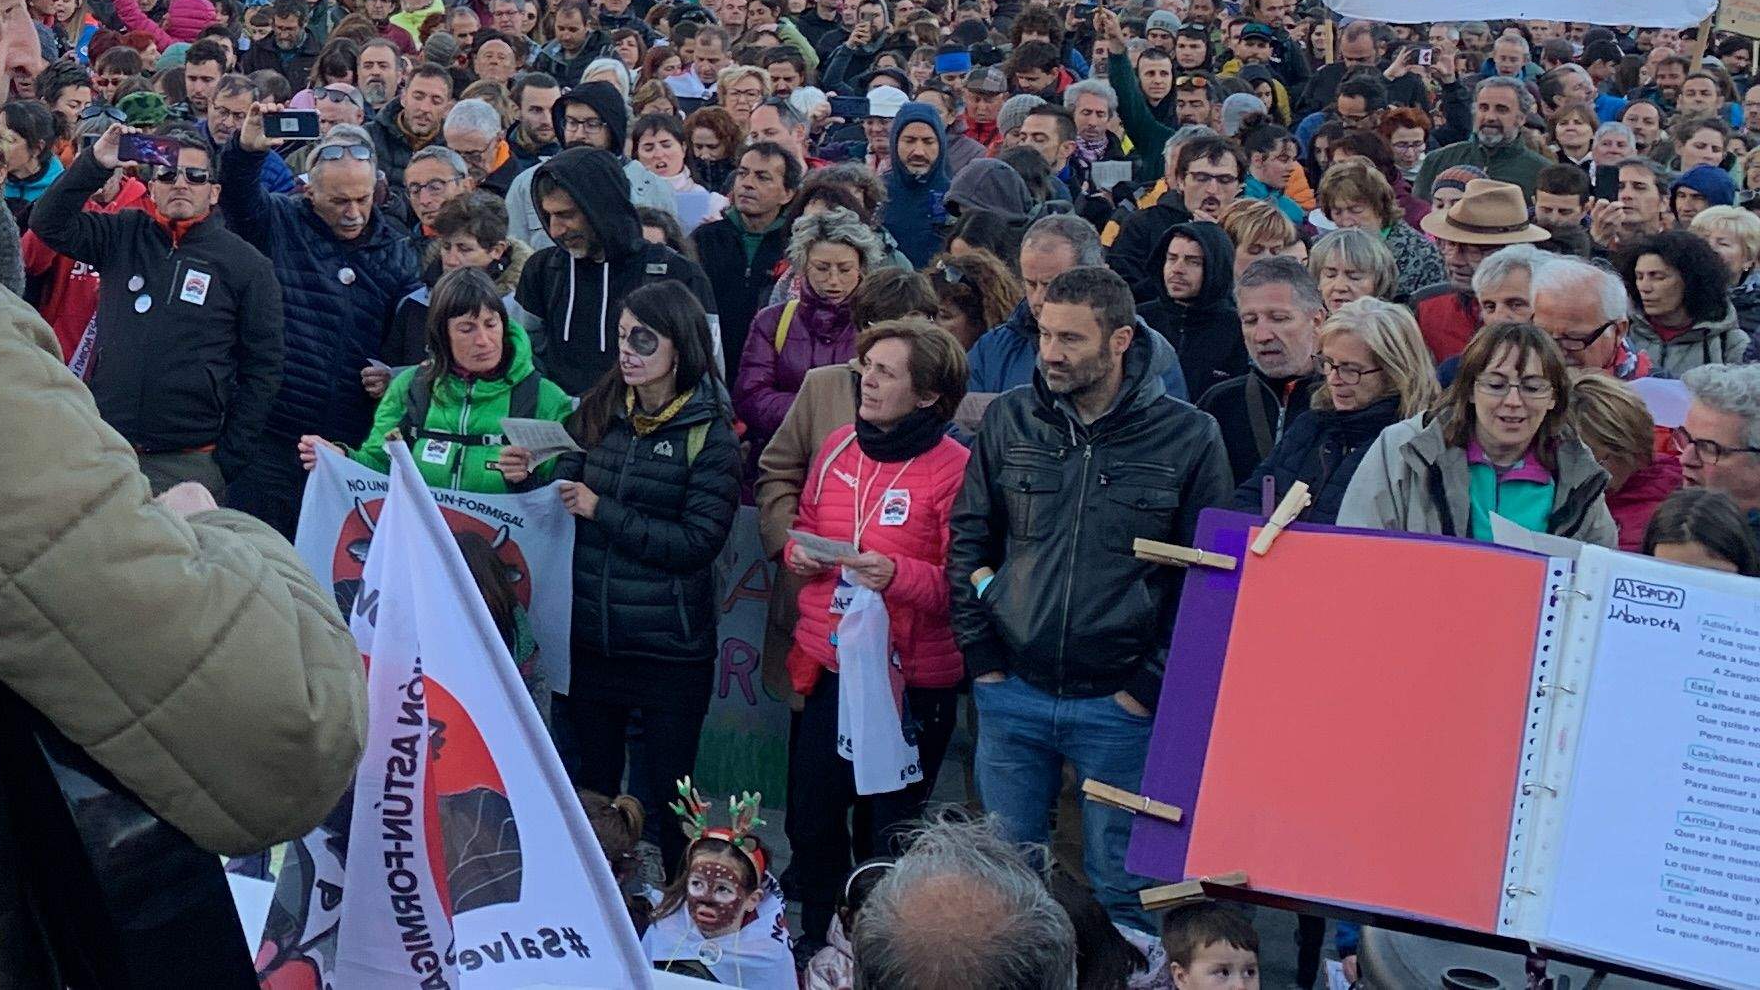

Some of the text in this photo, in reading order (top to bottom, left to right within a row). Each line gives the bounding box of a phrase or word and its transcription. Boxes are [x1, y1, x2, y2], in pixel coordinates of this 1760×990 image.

[346, 479, 366, 492] NO
[1718, 637, 1734, 648] los
[1736, 641, 1757, 652] que
[1716, 688, 1729, 696] es
[1731, 689, 1741, 699] la
[1696, 699, 1709, 708] La
[1696, 714, 1718, 725] Que
[1699, 730, 1724, 742] Pero
[1726, 737, 1746, 746] eso
[1691, 748, 1711, 760] Las
[1680, 762, 1695, 772] Se
[1684, 778, 1709, 790] Para
[1674, 828, 1696, 839] Que
[1699, 833, 1712, 843] ya
[1714, 836, 1728, 846] ha
[1664, 842, 1680, 852] De
[1681, 846, 1711, 859] tener
[1712, 853, 1727, 862] en
[1664, 858, 1679, 868] Lo
[1680, 863, 1702, 873] que
[1703, 867, 1724, 878] nos
[1668, 895, 1682, 905] Es
[1731, 893, 1753, 903] que
[1656, 908, 1679, 920] Que
[1680, 913, 1711, 927] lucha
[1712, 921, 1753, 937] porque
[1656, 924, 1677, 936] Los
[1679, 930, 1700, 940] que
